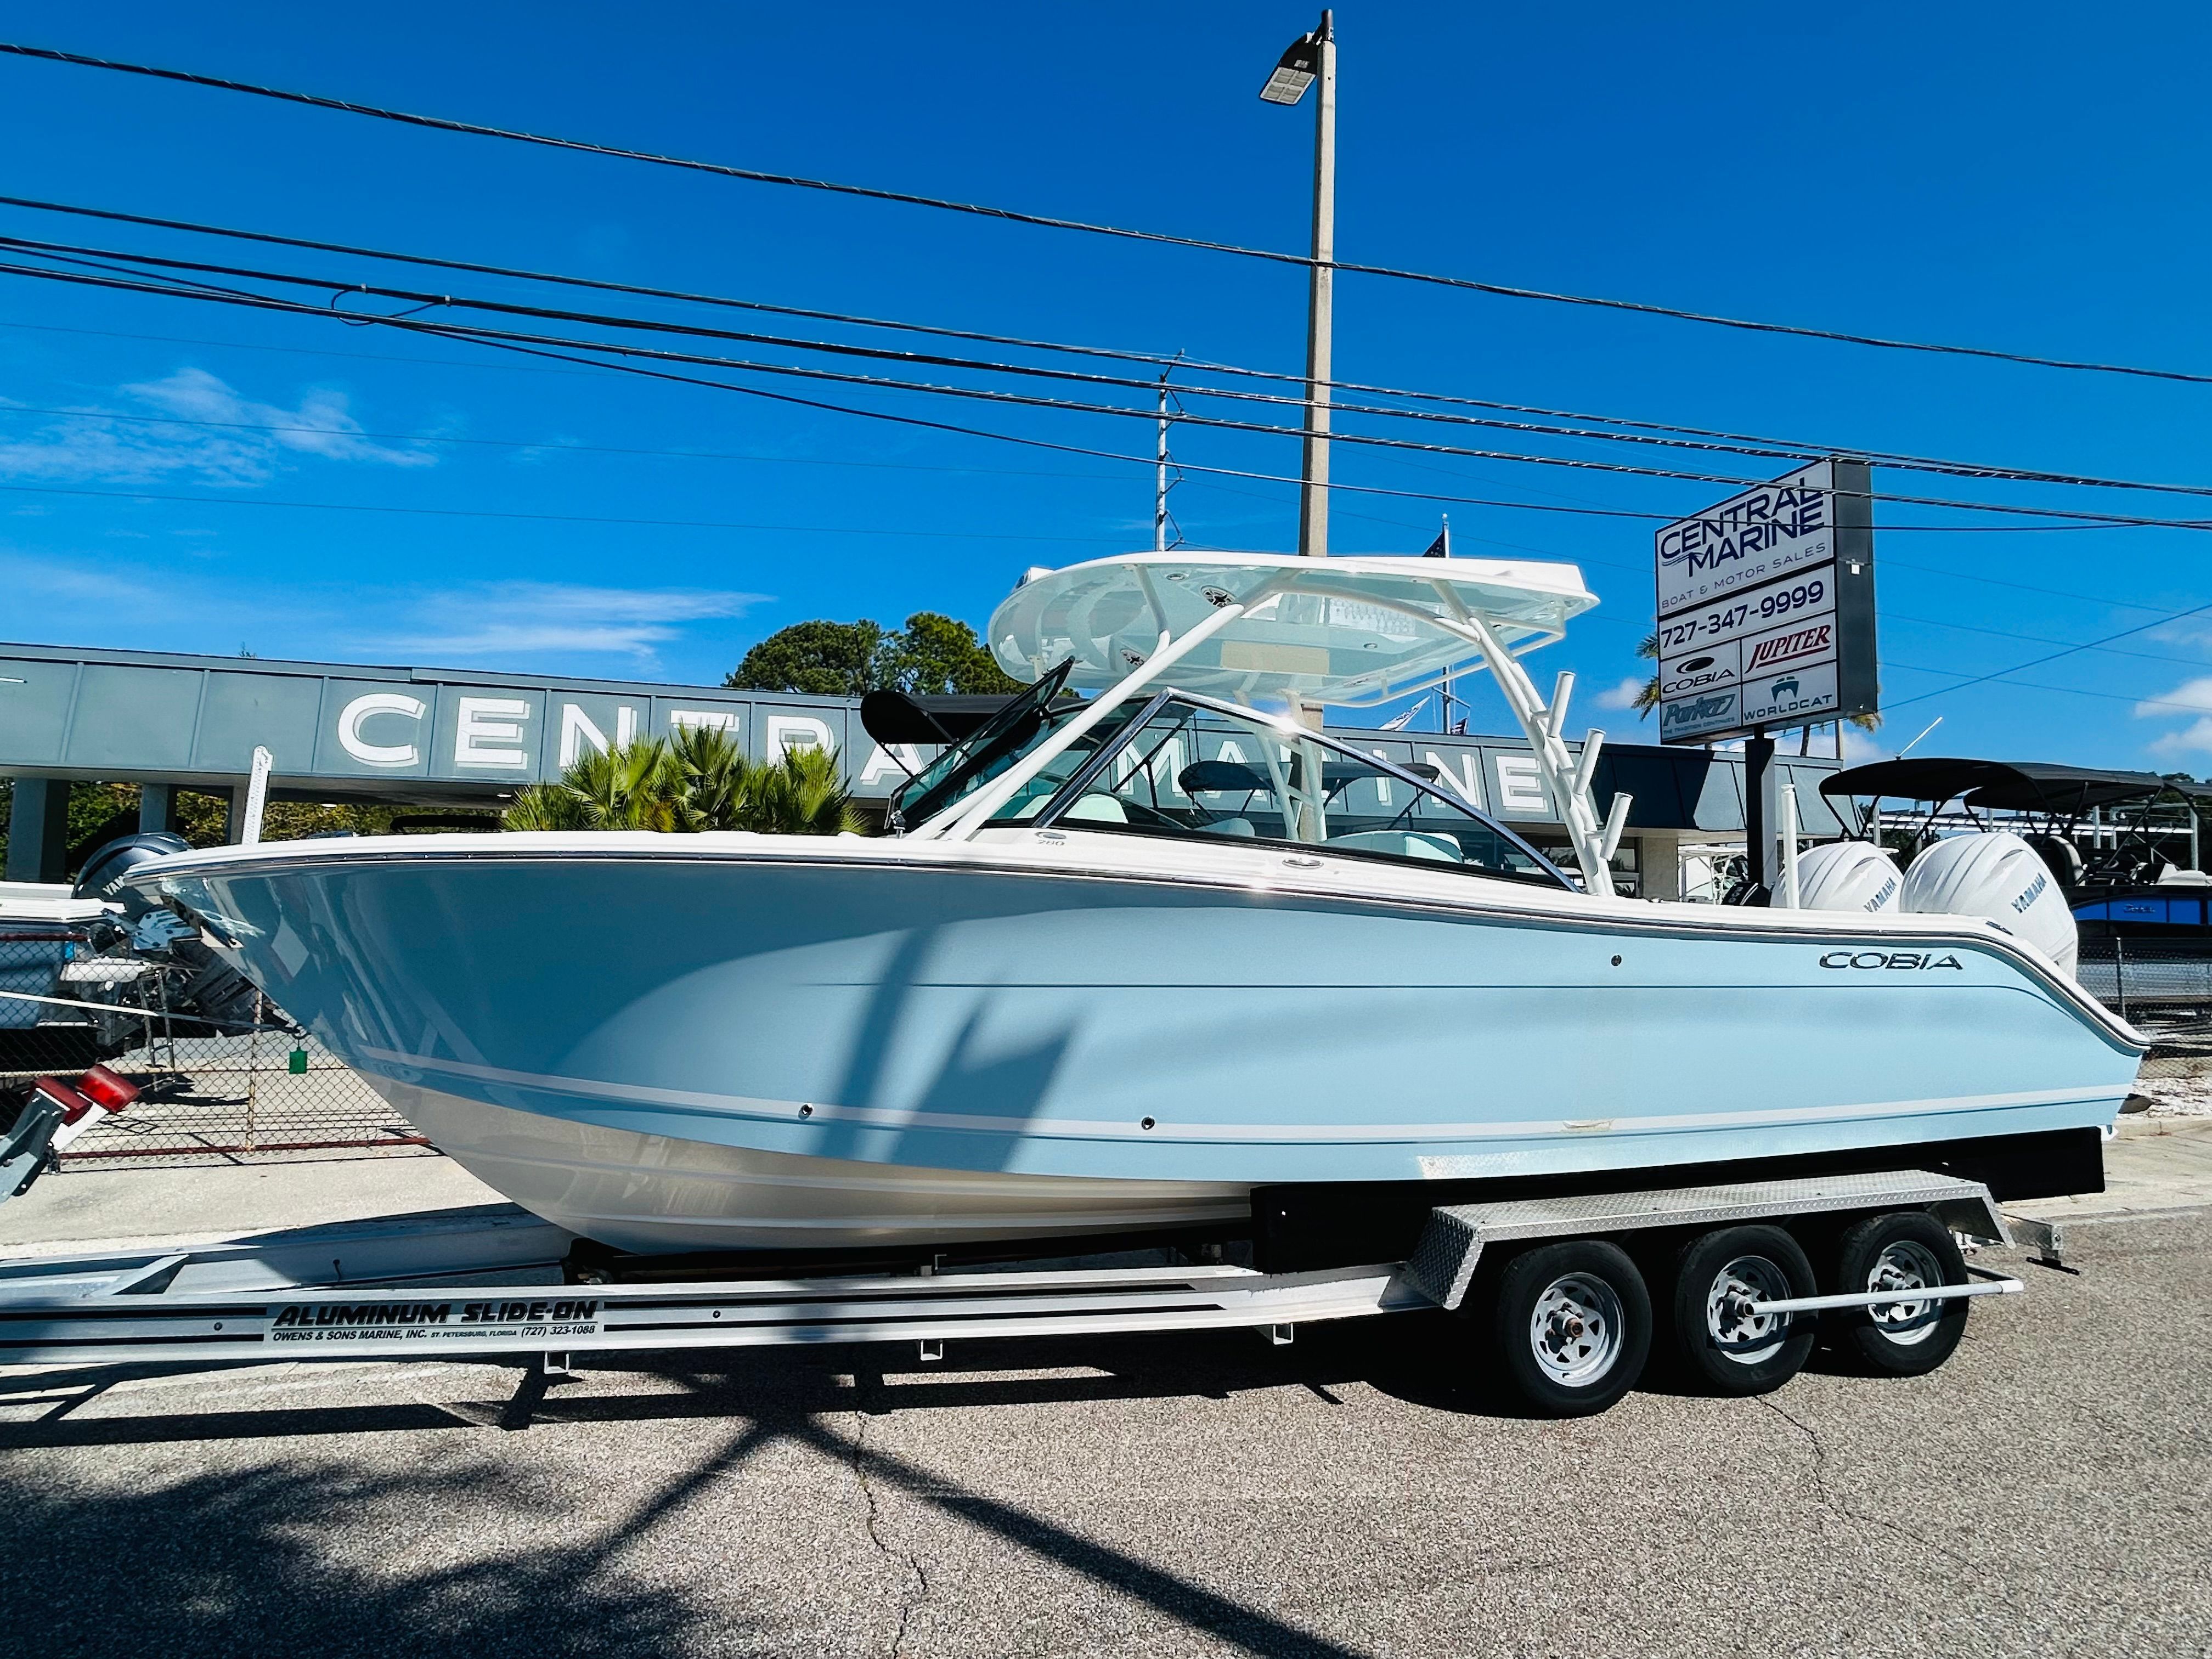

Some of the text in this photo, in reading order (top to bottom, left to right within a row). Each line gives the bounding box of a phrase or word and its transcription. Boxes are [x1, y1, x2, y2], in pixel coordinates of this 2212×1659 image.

[1661, 477, 1824, 559] CENTRAL
[1689, 500, 1825, 578] MARINE
[1661, 542, 1826, 609] BOAT & MOTOR SALES
[1661, 580, 1824, 648] 727-347-9999
[1745, 624, 1831, 674] JUPITER
[1662, 668, 1735, 693] COBIA
[1663, 693, 1736, 726] Parker
[1744, 694, 1833, 720] WORLDCAT
[337, 692, 1548, 812] CENRA MINE
[102, 876, 126, 896] YAM
[1863, 877, 1897, 913] YAMAHA
[2010, 872, 2047, 914] YAMAHA
[1819, 951, 1963, 970] COBIA
[273, 1300, 598, 1326] ALUMINUM SLIDE-ON
[273, 1330, 314, 1341] OWENS
[315, 1331, 324, 1340] &
[326, 1330, 357, 1341] SONS
[358, 1329, 403, 1341] MARINE,
[405, 1329, 427, 1339] INC.
[521, 1325, 547, 1338] (727)
[550, 1325, 596, 1335] 323-1088
